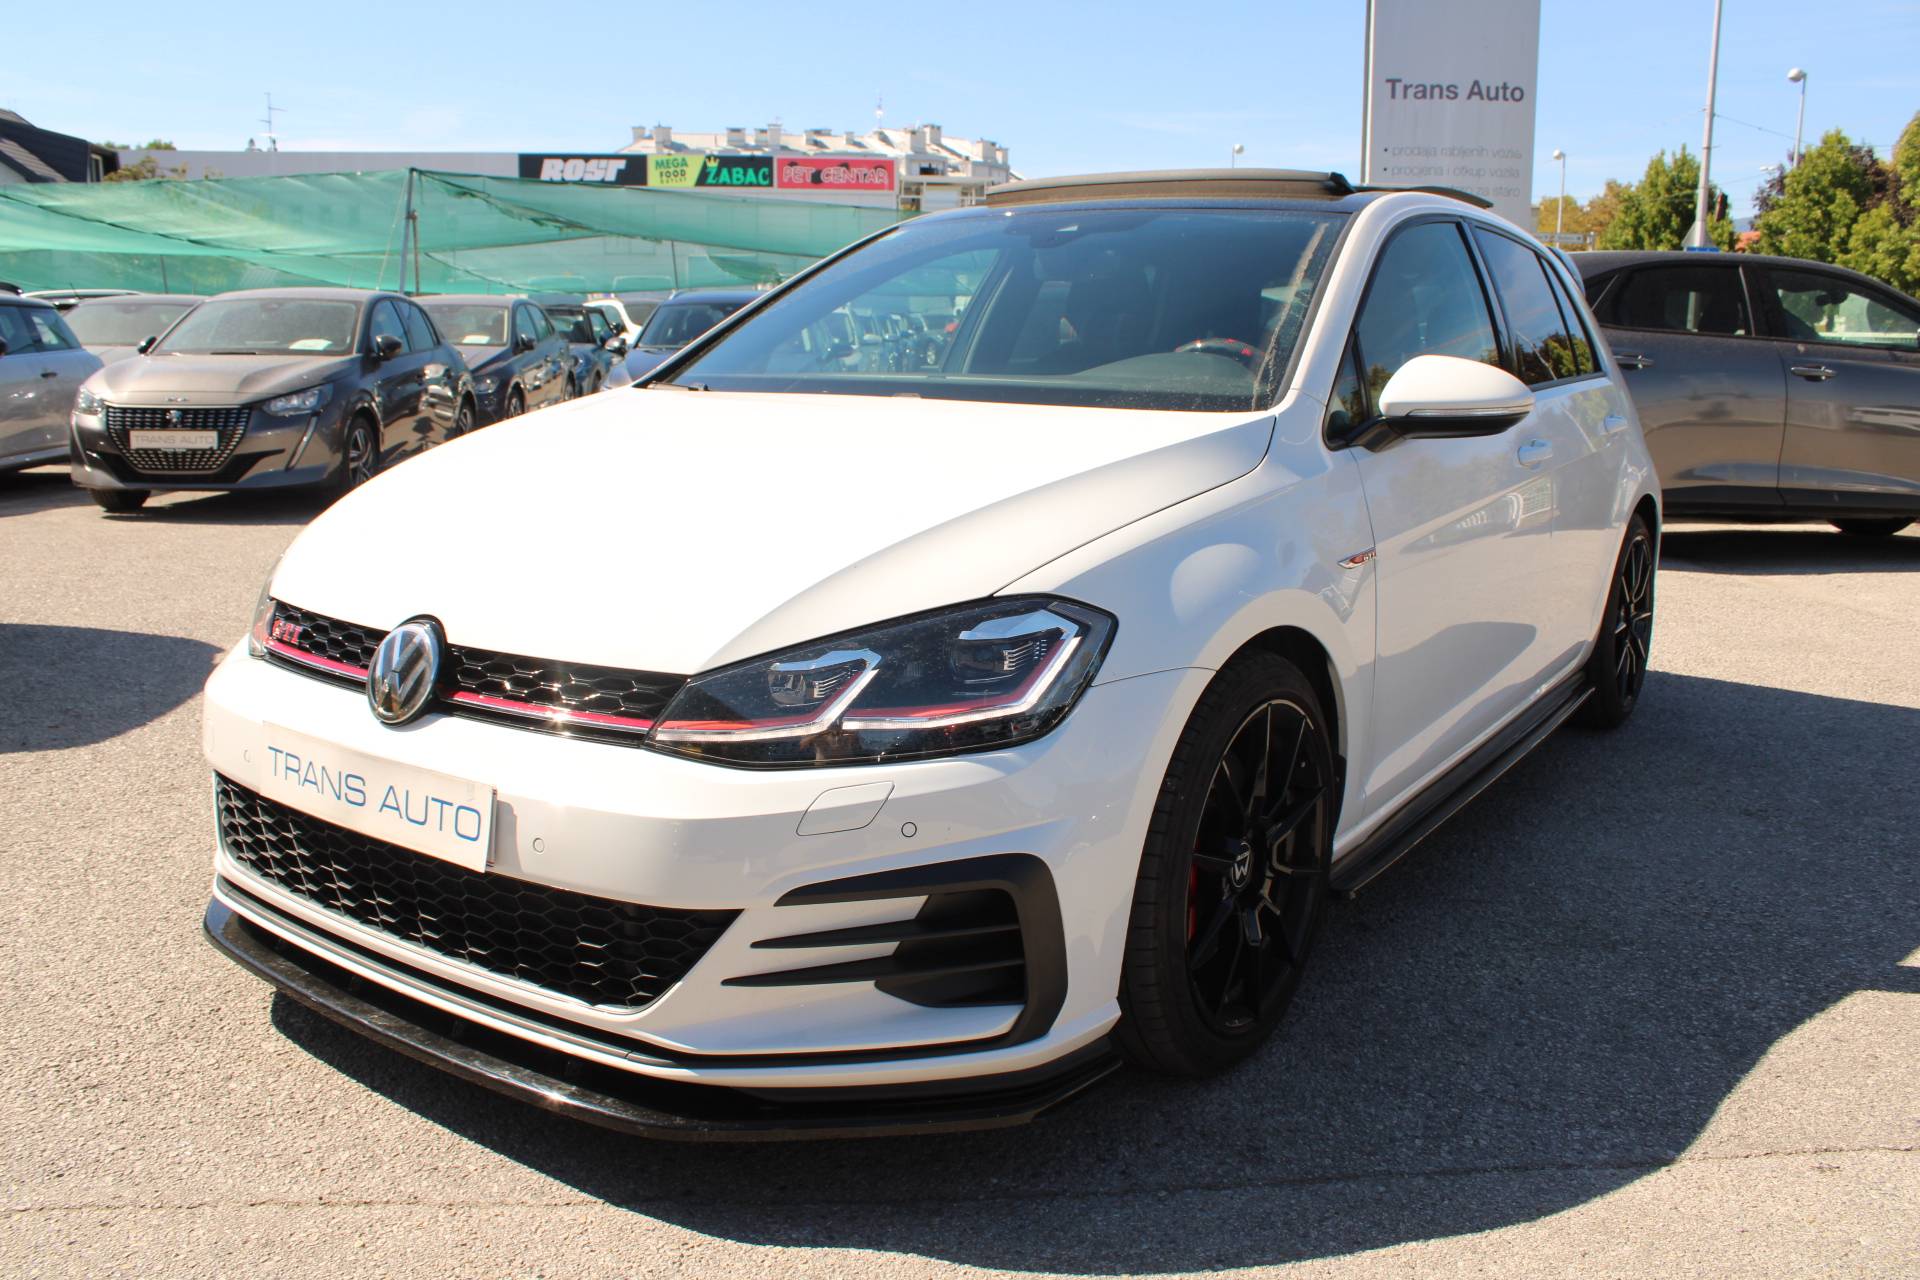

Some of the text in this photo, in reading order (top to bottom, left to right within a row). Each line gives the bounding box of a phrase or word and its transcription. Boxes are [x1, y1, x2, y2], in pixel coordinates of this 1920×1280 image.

[1385, 78, 1525, 102] Trans Auto
[655, 157, 688, 170] MEGA
[659, 169, 687, 178] FOOD
[782, 166, 888, 184] PET CENTAR
[133, 435, 215, 444] TRANS AUTO
[268, 745, 481, 842] TRANS AUTO
